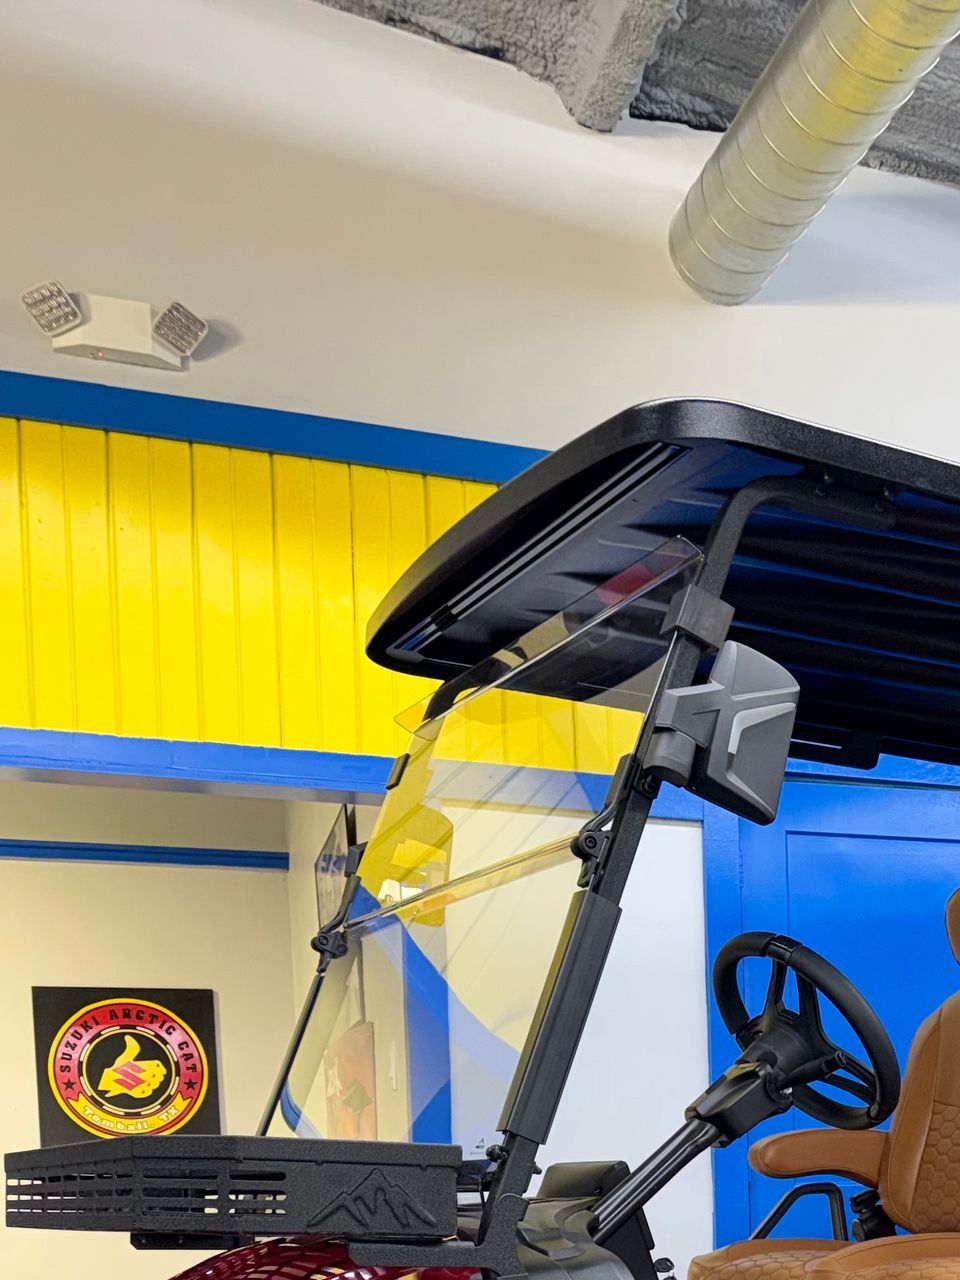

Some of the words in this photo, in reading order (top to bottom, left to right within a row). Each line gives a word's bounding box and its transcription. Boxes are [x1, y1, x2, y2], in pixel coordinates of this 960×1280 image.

[60, 1015, 101, 1073] SUZUKI
[108, 1007, 177, 1037] ARCTIC
[177, 1041, 198, 1073] CAT
[158, 1105, 180, 1122] TX
